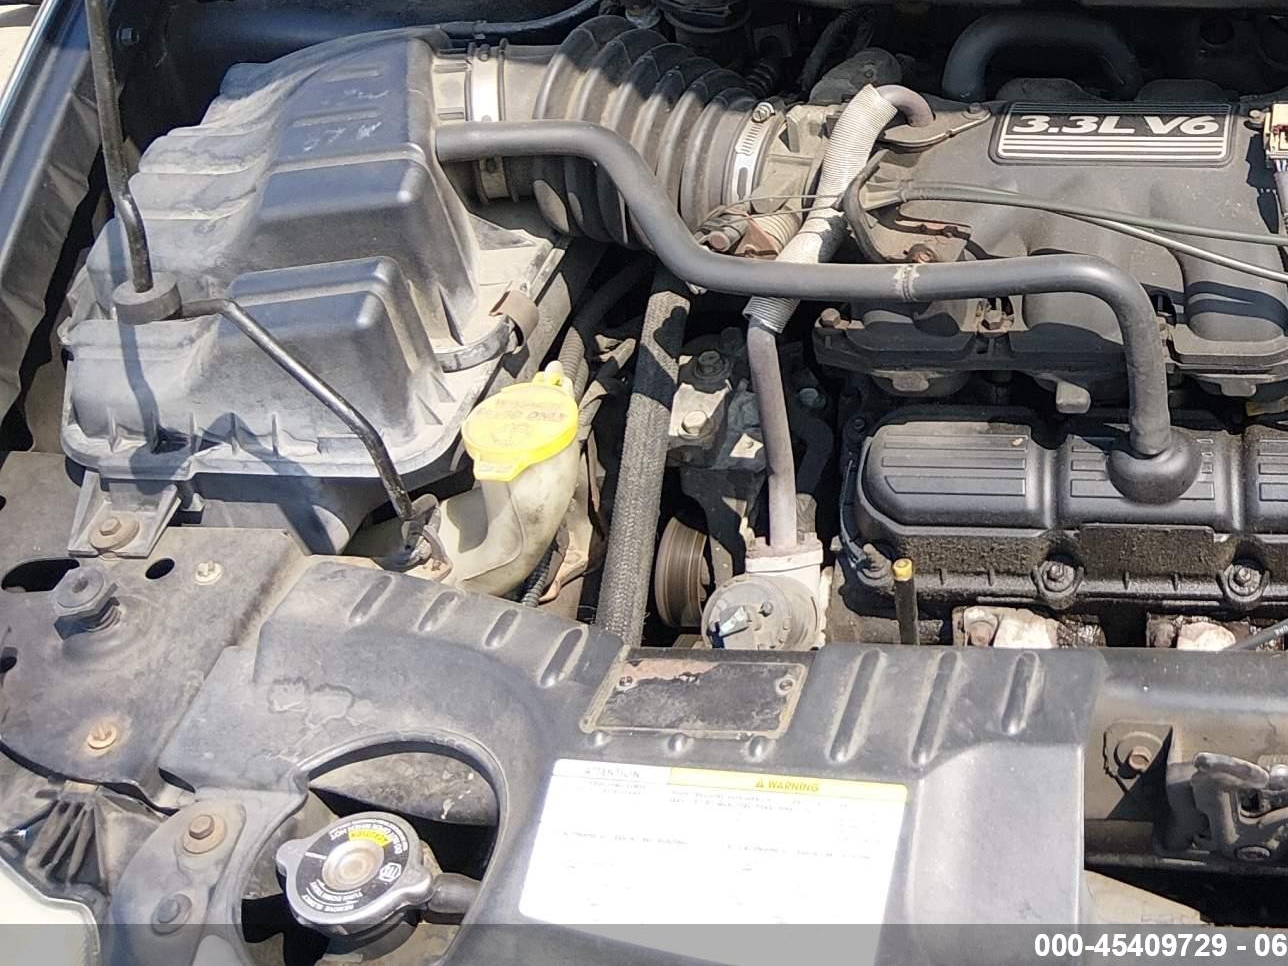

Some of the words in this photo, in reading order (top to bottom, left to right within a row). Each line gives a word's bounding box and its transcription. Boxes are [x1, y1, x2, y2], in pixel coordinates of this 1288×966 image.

[1012, 115, 1135, 134] 3.3L
[1143, 115, 1219, 135] V6
[767, 778, 820, 793] WARNING
[329, 827, 348, 841] HOT
